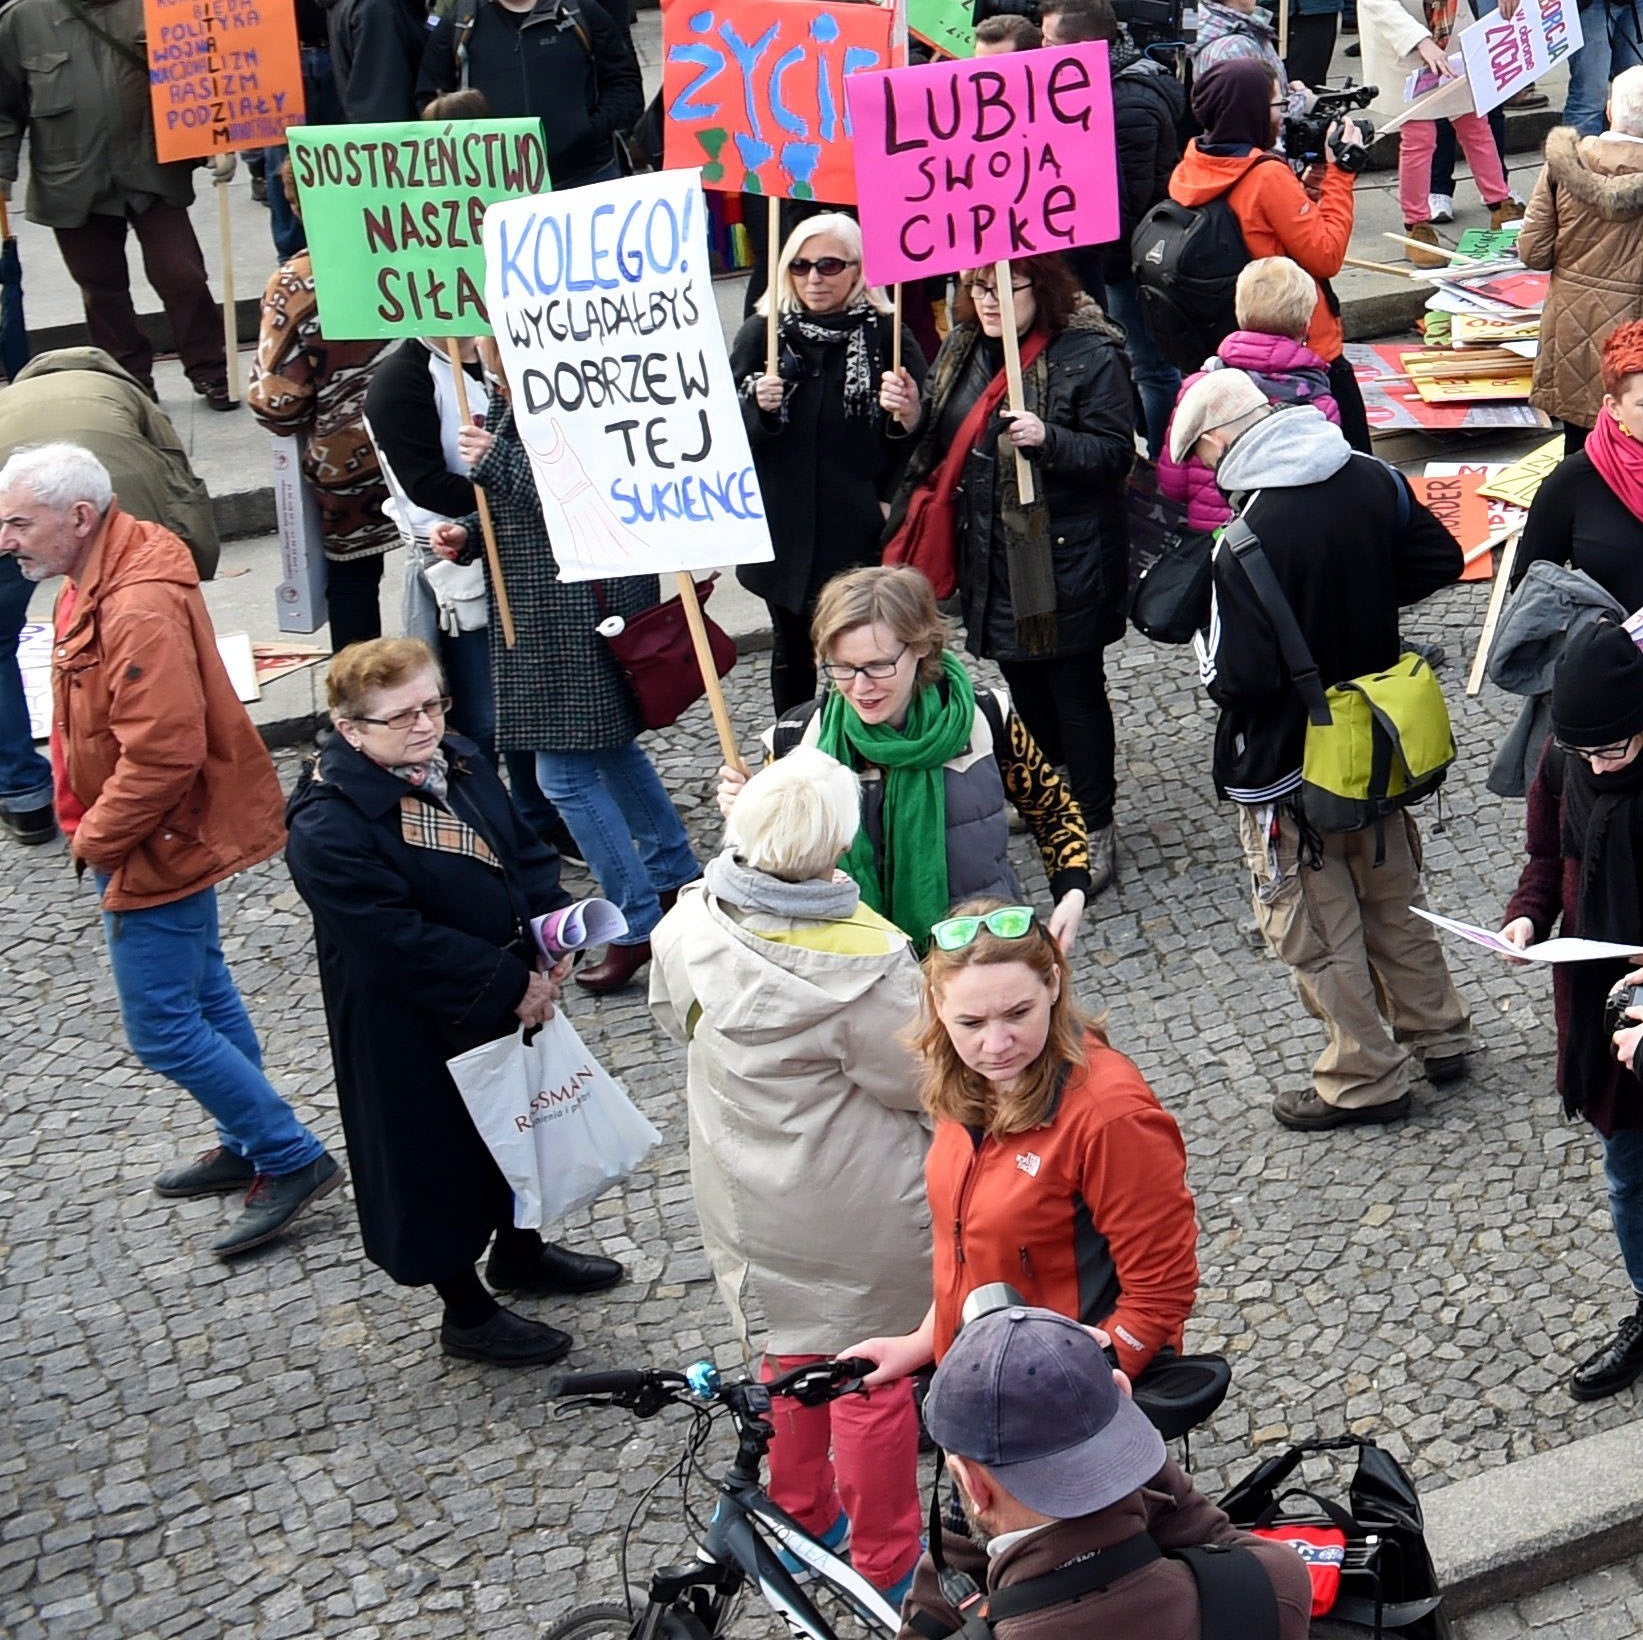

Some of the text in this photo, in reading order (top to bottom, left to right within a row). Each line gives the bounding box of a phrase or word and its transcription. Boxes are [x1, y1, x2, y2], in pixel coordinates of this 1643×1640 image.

[293, 123, 547, 195] SIOSTRZEŃSTWO
[499, 188, 695, 300] KOLEGO!
[376, 266, 491, 324] SIŁA
[505, 278, 700, 350] WYGLĄDAŁBYŚ
[521, 348, 711, 416] DOBRZE W
[603, 408, 714, 471] TEJ
[609, 465, 765, 527] SUKIENCE
